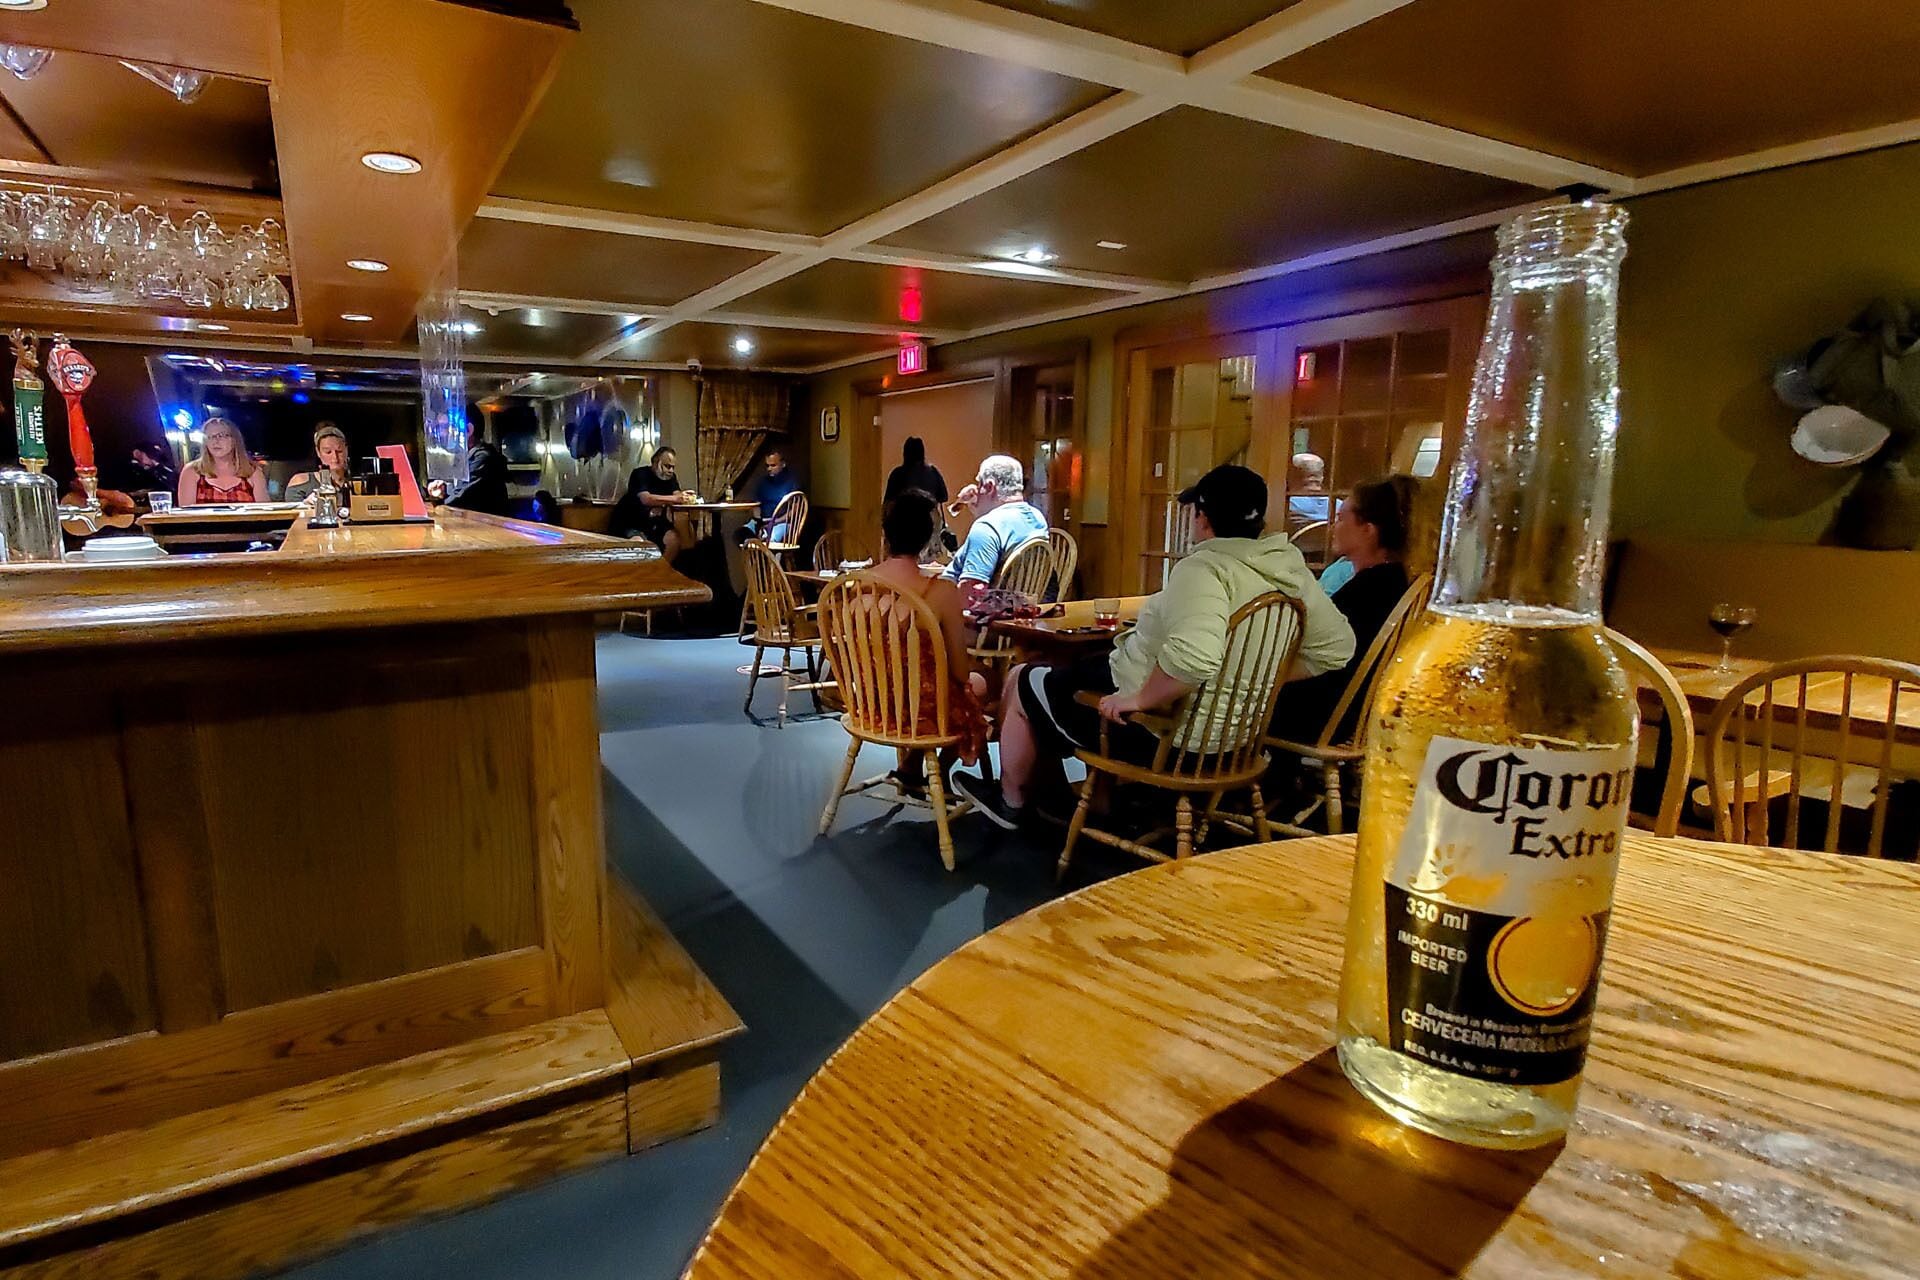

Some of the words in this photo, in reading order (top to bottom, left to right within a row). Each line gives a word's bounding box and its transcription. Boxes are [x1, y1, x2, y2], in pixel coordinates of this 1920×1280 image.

[900, 345, 919, 371] EXIT
[33, 405, 44, 444] KEITH'S
[1406, 896, 1440, 923] 330
[1442, 912, 1469, 931] ml
[1397, 929, 1468, 964] IMPORTED
[1410, 949, 1450, 975] BEER
[1401, 1007, 1497, 1050] CERVECERIA
